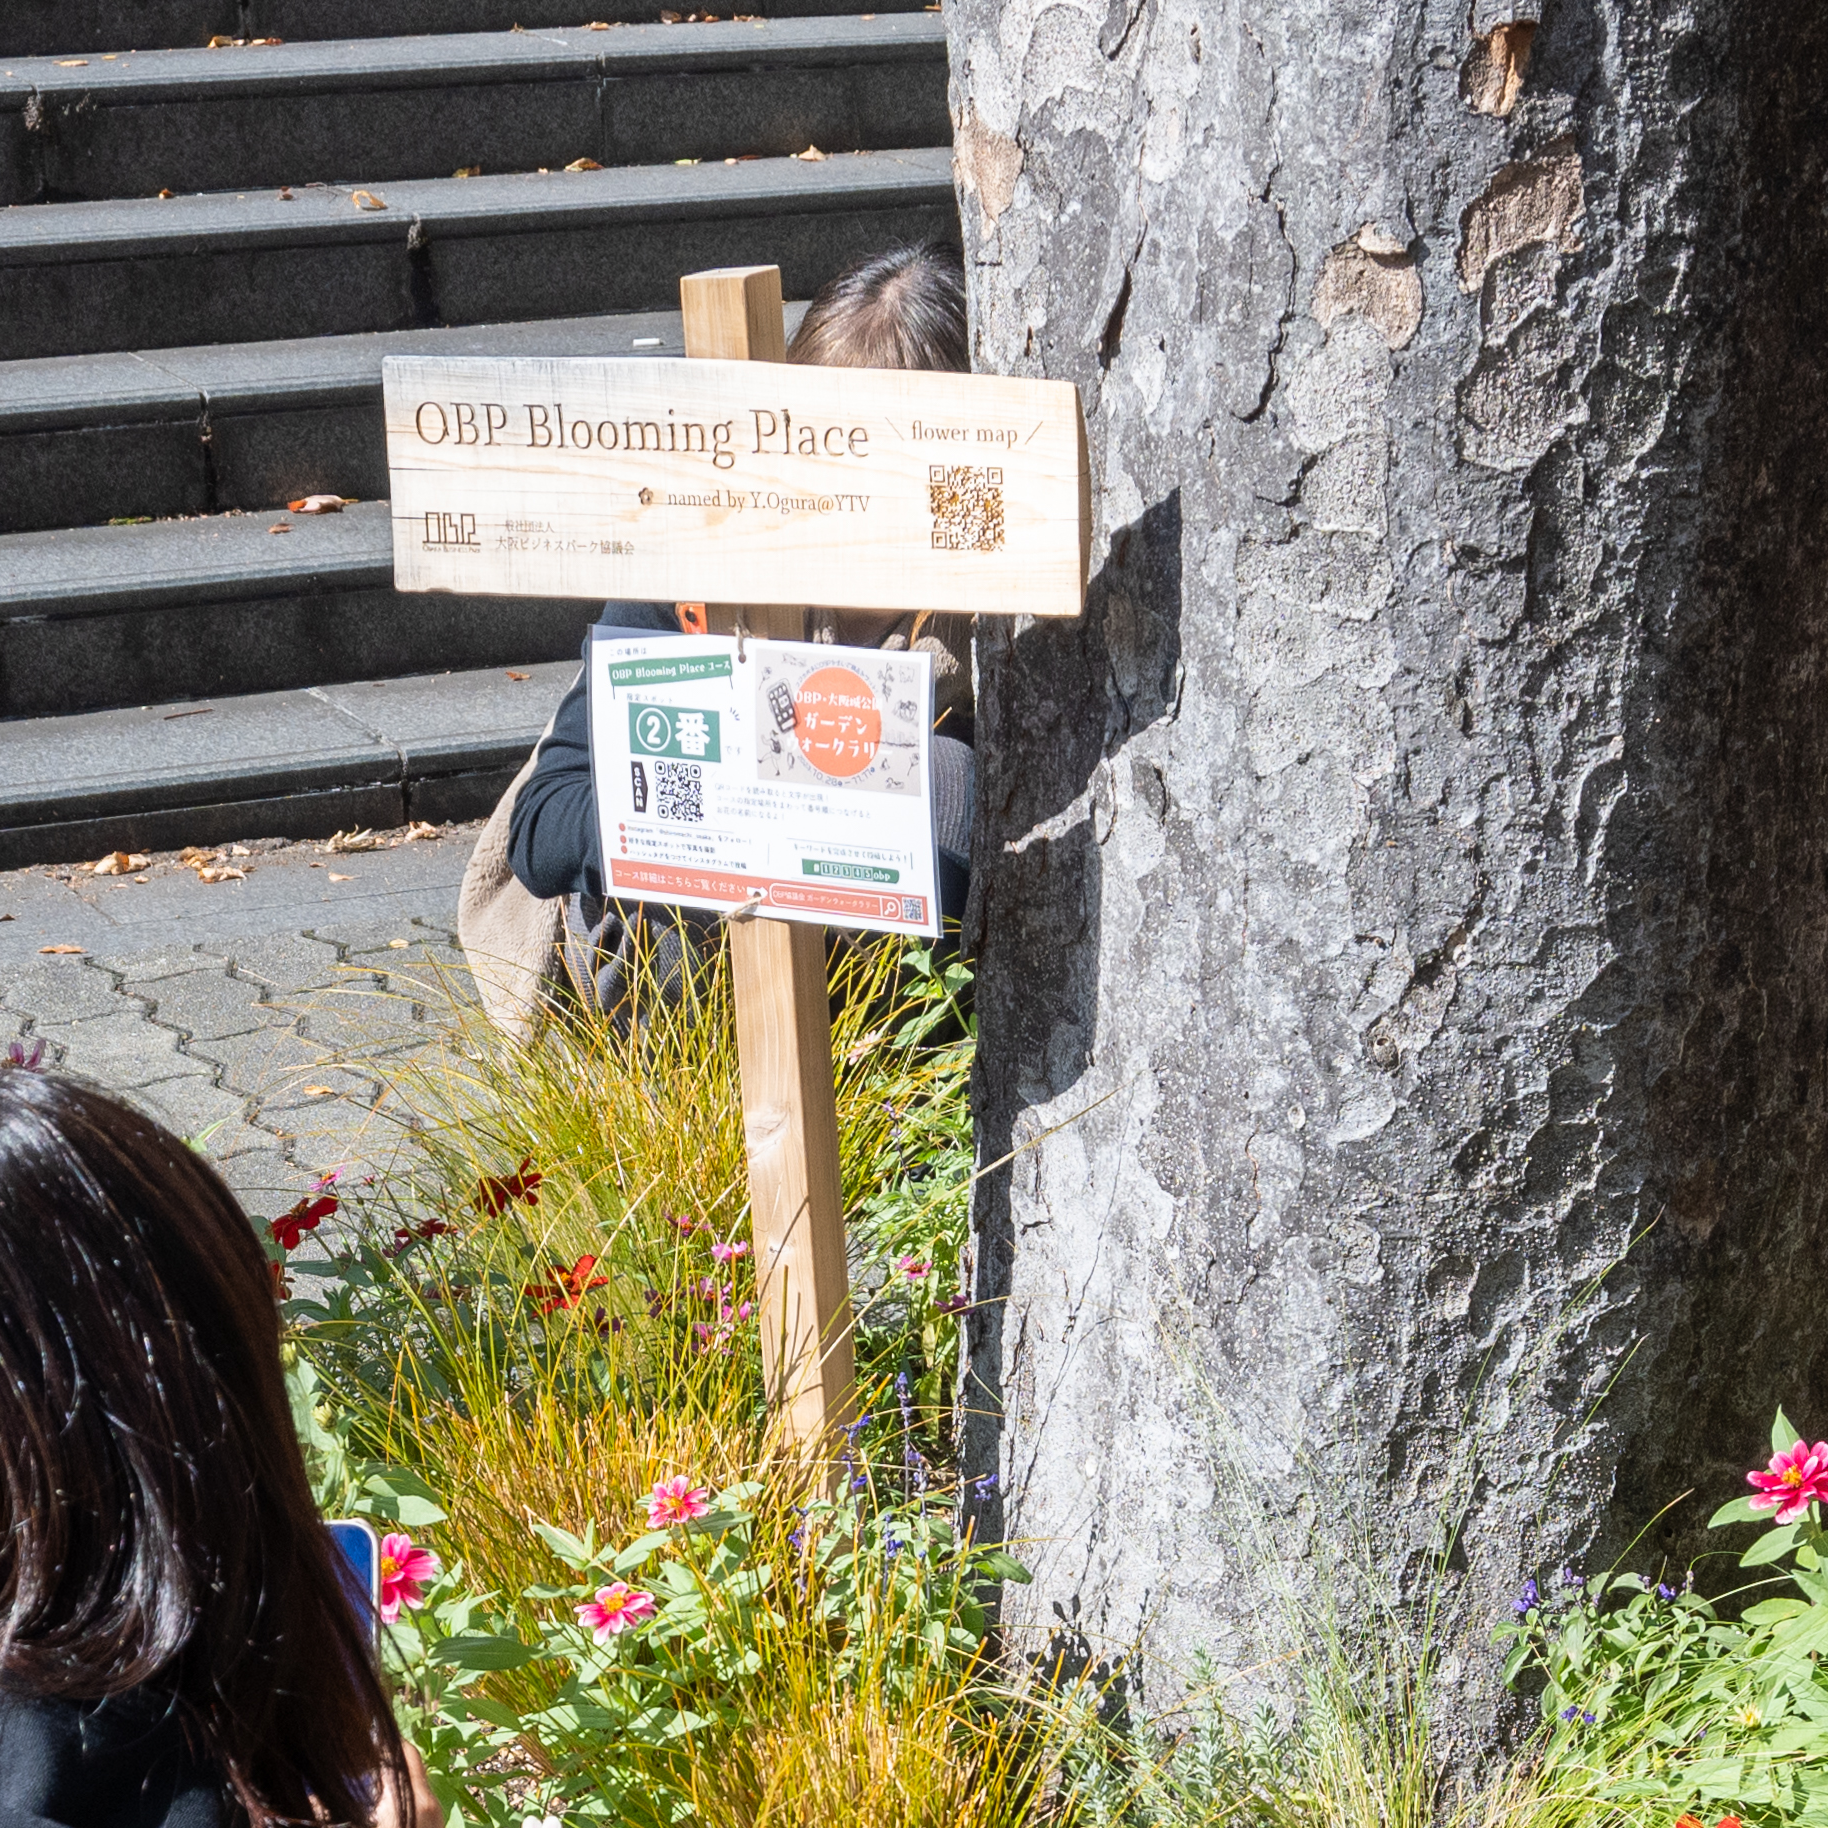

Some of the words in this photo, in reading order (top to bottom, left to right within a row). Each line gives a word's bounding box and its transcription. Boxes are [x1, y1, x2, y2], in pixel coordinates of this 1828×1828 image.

[414, 401, 509, 447] OBP
[524, 403, 735, 470] Blooming
[749, 408, 870, 457] Place
[911, 420, 969, 443] flower
[976, 424, 1019, 449] map
[667, 490, 722, 509] named
[727, 489, 747, 511] by
[749, 490, 870, 515] Y.Ogura@YTV
[495, 536, 635, 556] 大阪ビジネスパーク協議会
[612, 668, 632, 680] OBP
[635, 665, 676, 678] Blooming
[679, 662, 706, 674] Place
[707, 661, 731, 672] コース
[626, 692, 673, 704] 指定スポット
[804, 711, 867, 734] ガーデン
[633, 767, 644, 808] SCAN
